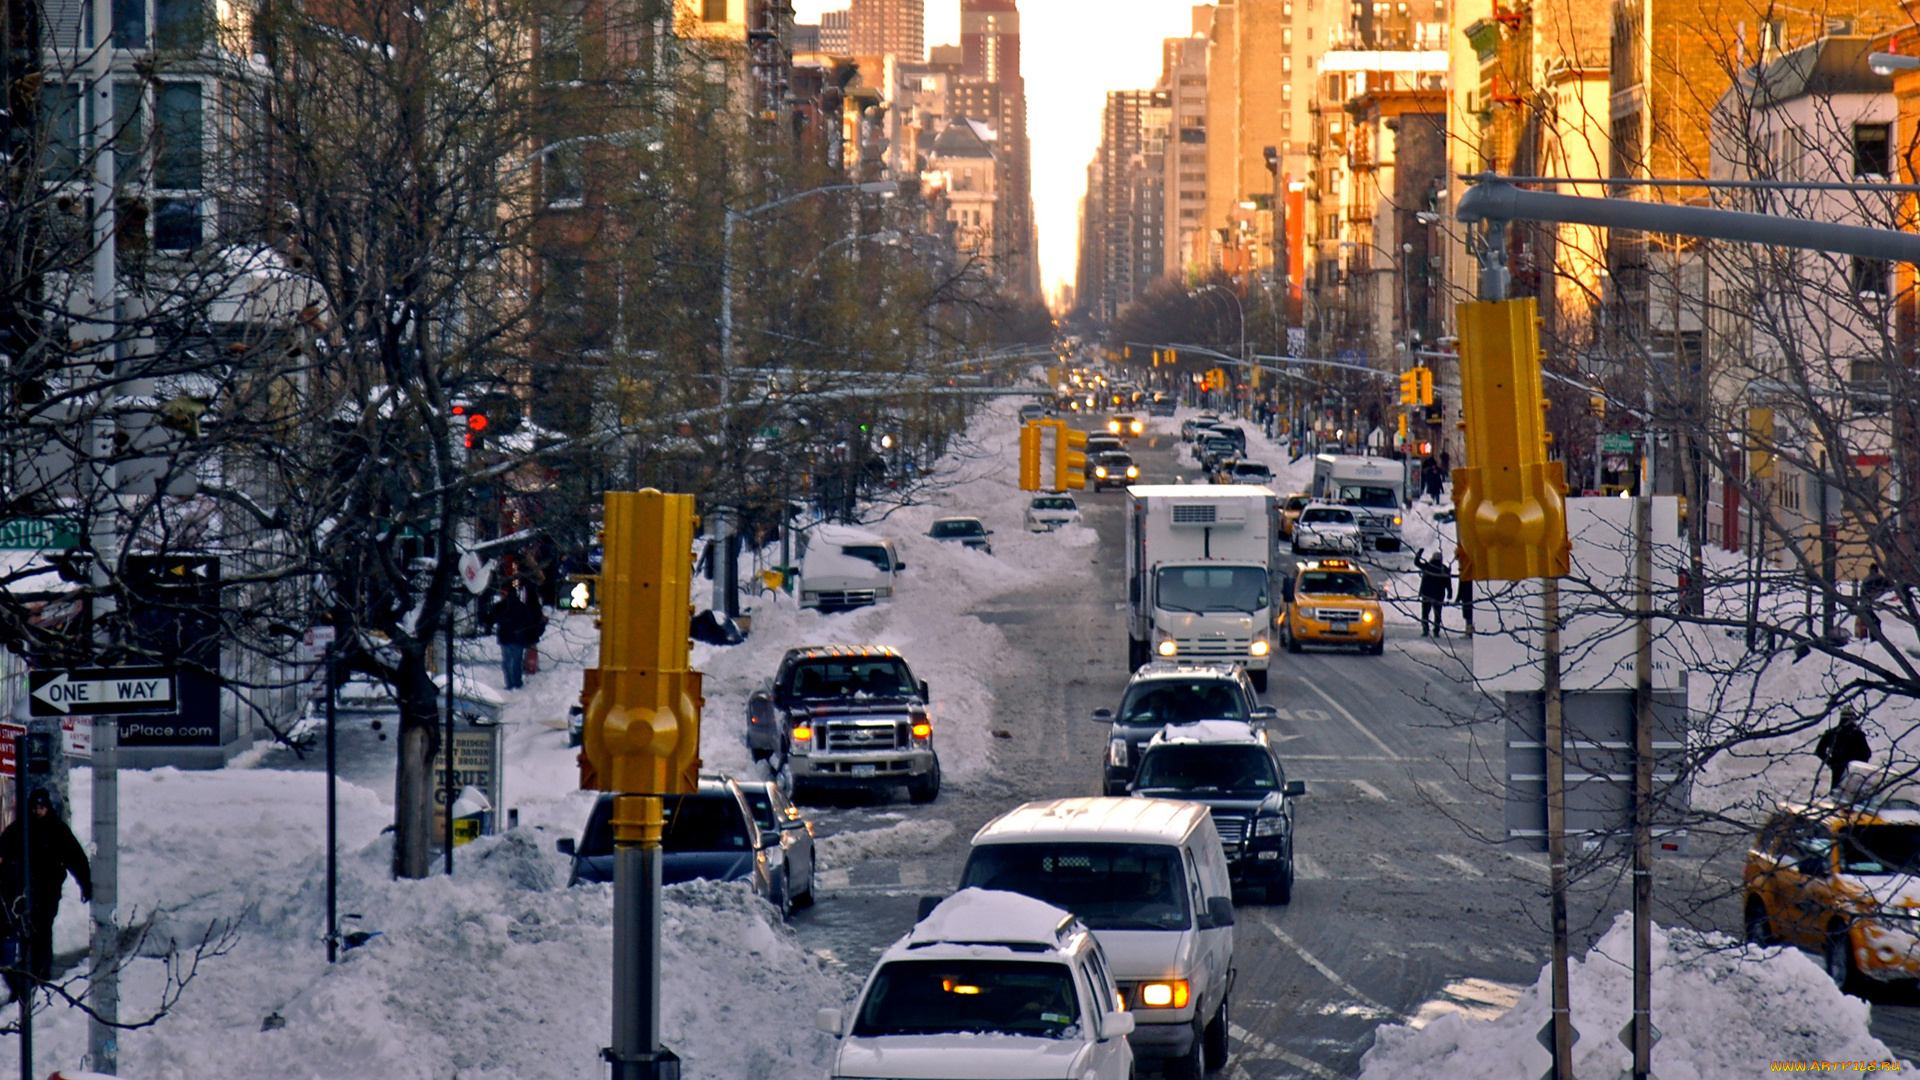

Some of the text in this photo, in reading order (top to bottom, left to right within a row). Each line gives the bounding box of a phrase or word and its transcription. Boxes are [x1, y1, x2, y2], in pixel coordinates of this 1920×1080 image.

[1618, 661, 1670, 671] SKSKA
[49, 681, 158, 702] ONE WAY
[119, 724, 213, 739] yPlace.com
[434, 770, 489, 787] TRUE
